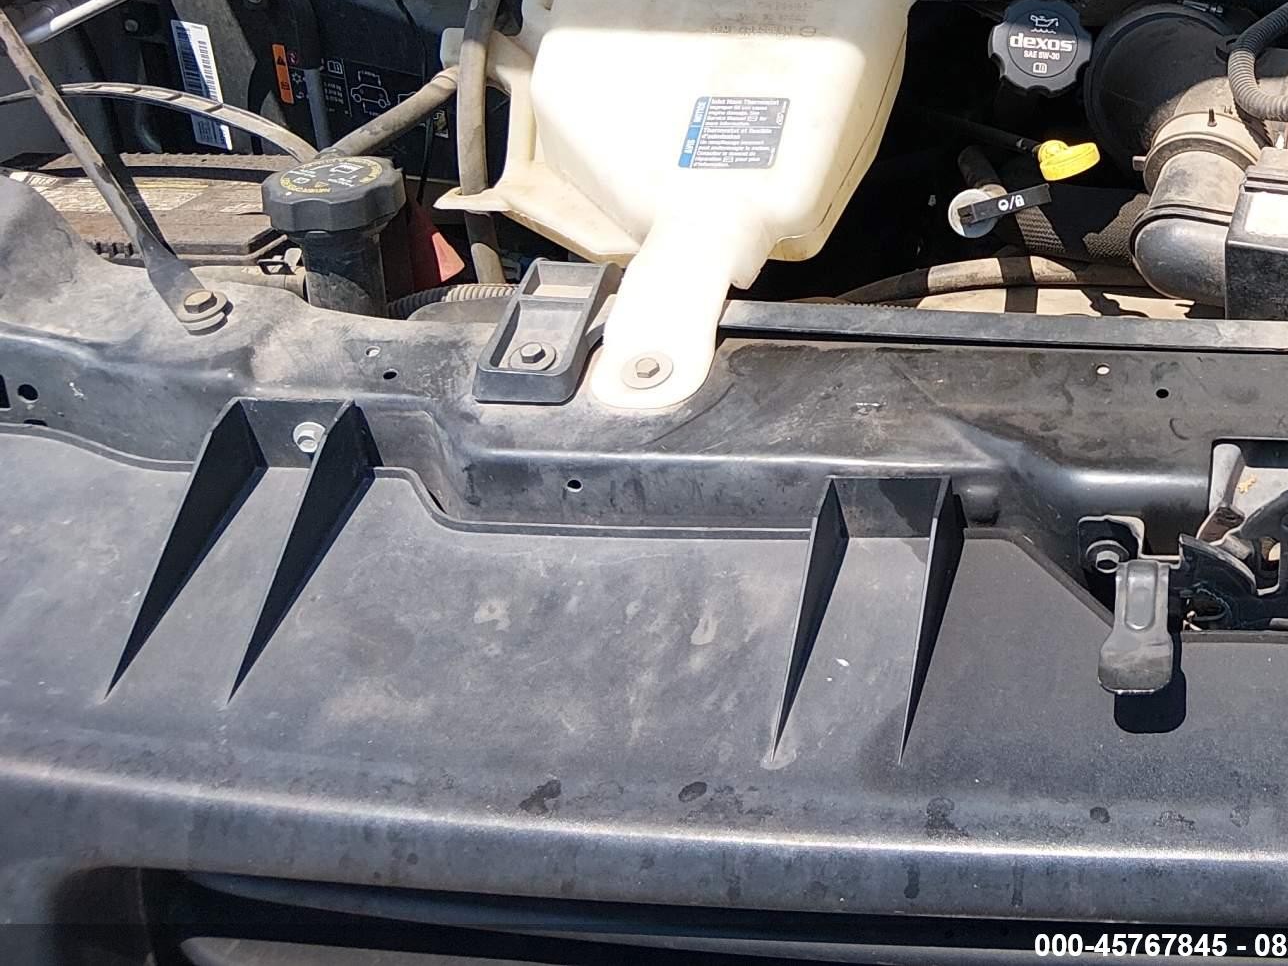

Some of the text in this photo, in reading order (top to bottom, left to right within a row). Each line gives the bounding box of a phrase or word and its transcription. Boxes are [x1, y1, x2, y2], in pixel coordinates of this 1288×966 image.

[1009, 32, 1074, 52] dexos
[1023, 50, 1060, 61] SAE 5W-30
